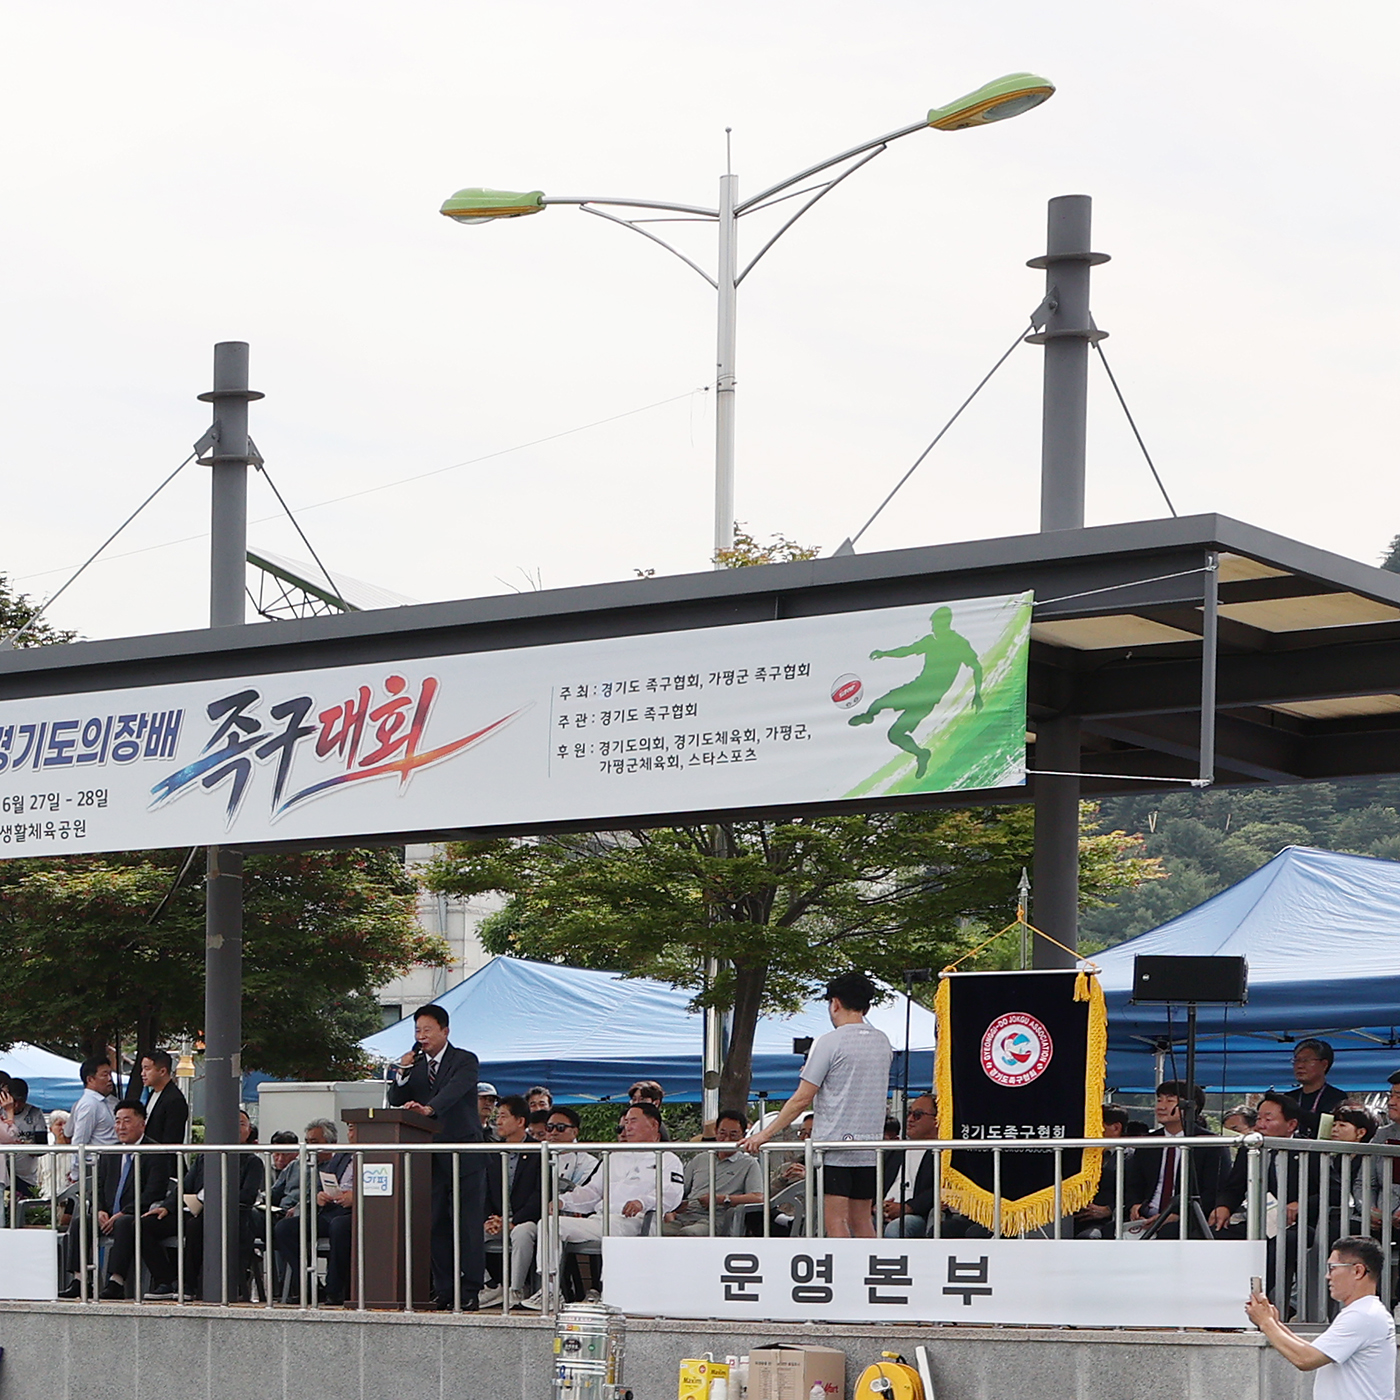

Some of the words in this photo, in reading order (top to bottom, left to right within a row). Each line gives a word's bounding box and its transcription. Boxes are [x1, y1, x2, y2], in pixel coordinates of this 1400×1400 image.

[601, 680, 640, 698] 경기도
[708, 669, 750, 687] 가평군
[754, 663, 811, 682] 족구협회
[600, 708, 639, 726] 경기도
[643, 703, 698, 721] 족구협회
[150, 674, 490, 829] 족구대회
[688, 748, 758, 767] 스타스포츠
[3, 794, 25, 814] 6월
[30, 792, 61, 811] 27일
[77, 788, 109, 808] 28일
[0, 819, 87, 843] 생활체육공원
[961, 1124, 1066, 1139] 경기도족구협회
